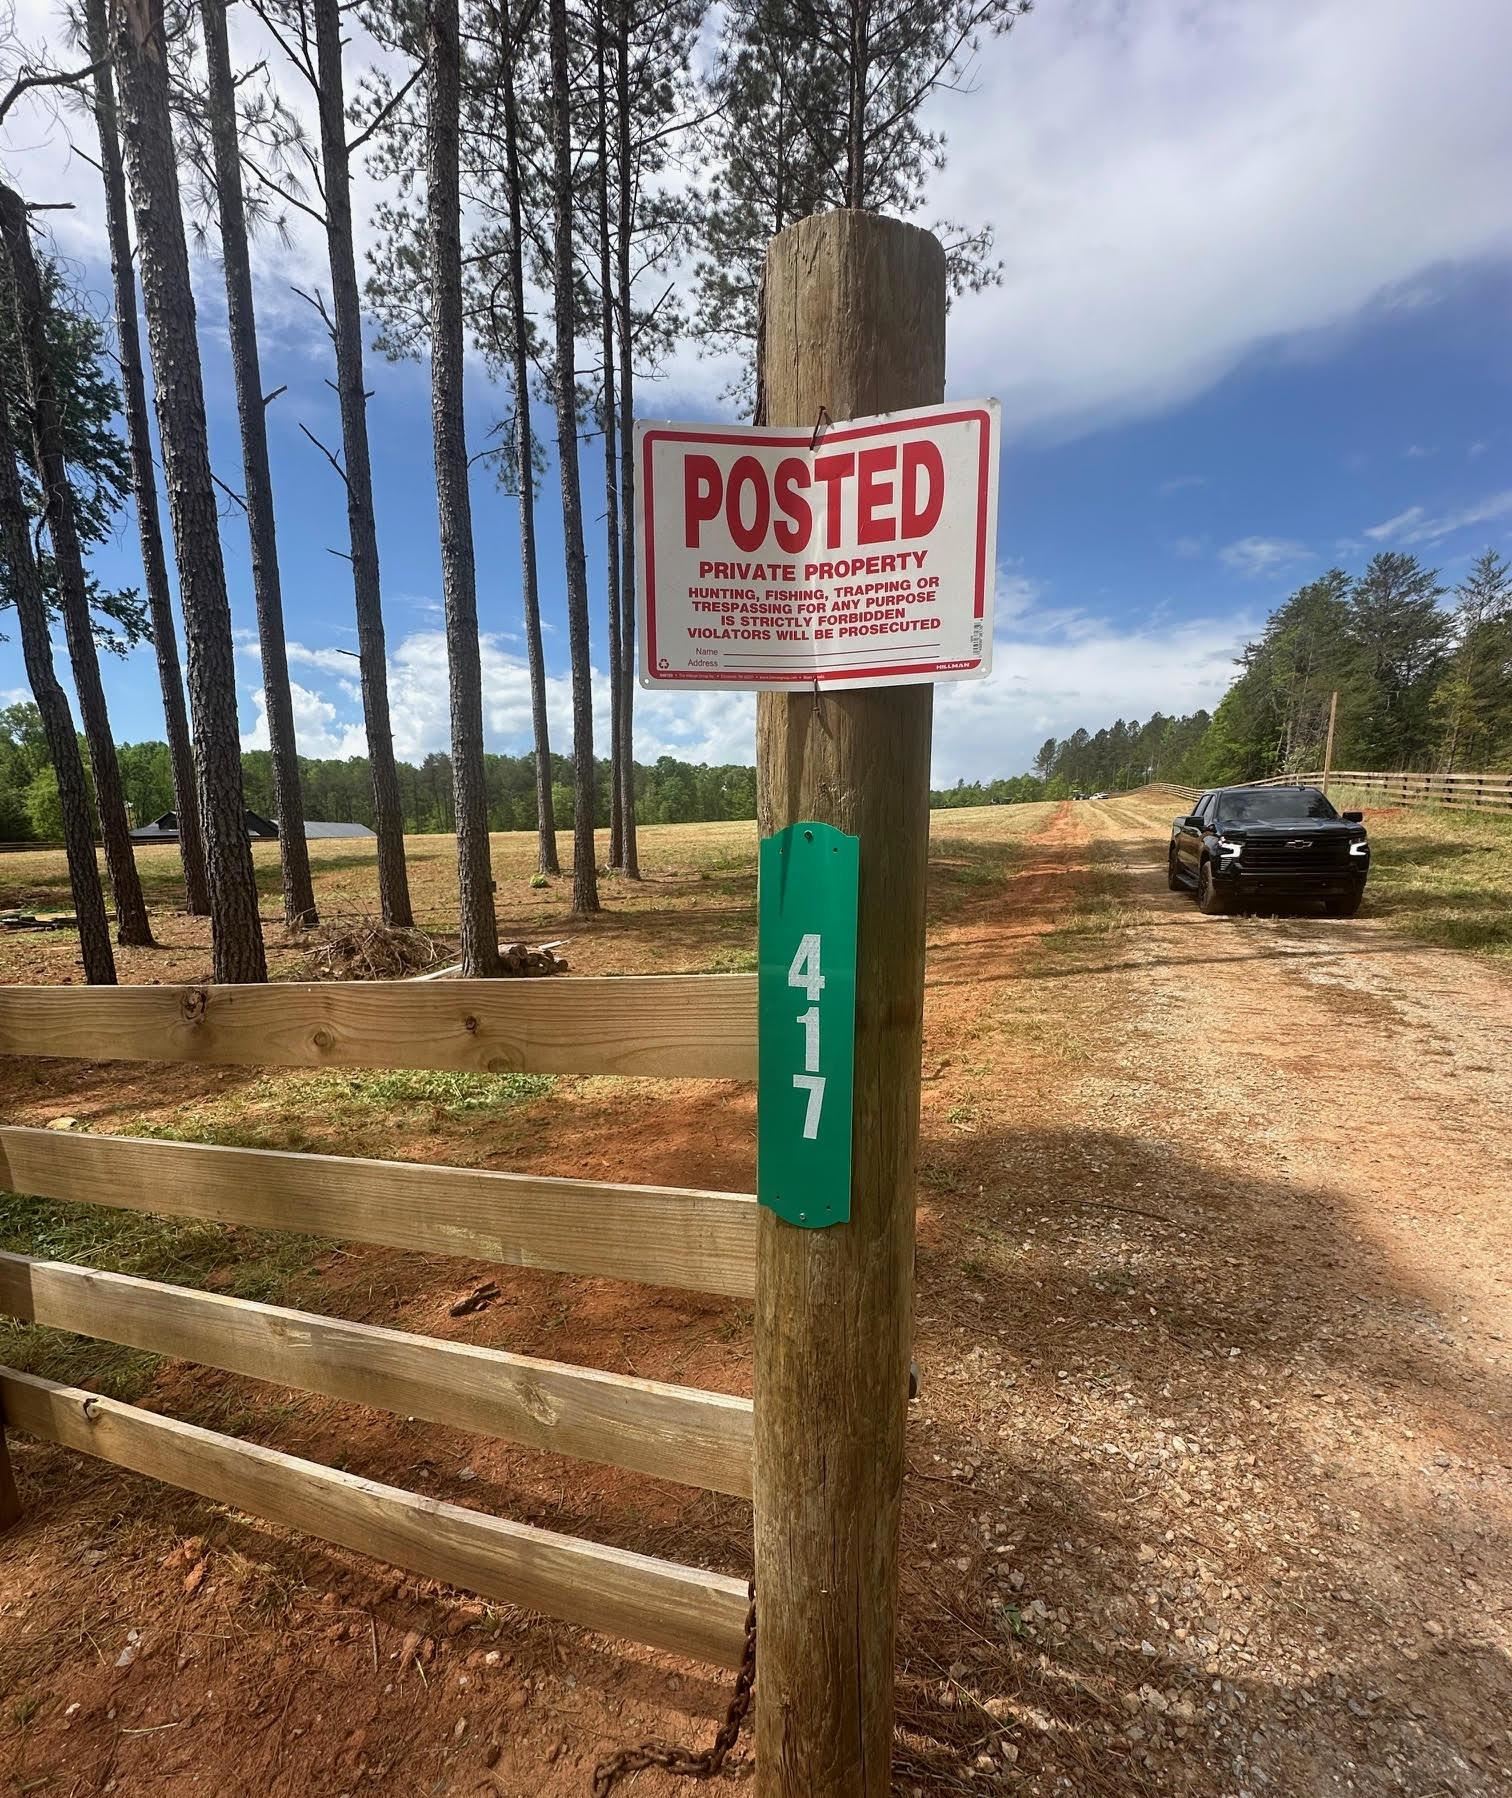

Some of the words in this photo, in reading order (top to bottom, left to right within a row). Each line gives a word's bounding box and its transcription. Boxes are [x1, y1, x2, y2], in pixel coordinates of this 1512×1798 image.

[684, 440, 945, 553] POSTED
[699, 561, 796, 581] PRIVATE
[805, 551, 928, 578] PROPERTY
[688, 587, 760, 601] HUNTING,
[765, 589, 829, 601] FISHING,
[834, 580, 912, 597] TRAPPING
[916, 576, 940, 588] OR
[693, 601, 793, 614] TRESPASSING
[797, 600, 827, 614] FOR
[831, 597, 861, 612] ANY
[866, 590, 936, 607] PURPOSE
[688, 628, 771, 640] VIOLATORS
[776, 629, 809, 640] WILL
[814, 627, 835, 639] BE
[839, 618, 941, 637] PROSECUTED
[721, 615, 736, 626] IS
[740, 616, 813, 627] STRICTLY
[818, 608, 906, 625] FORBIDDEN
[688, 658, 718, 668] Address
[696, 647, 718, 656] Name
[936, 662, 970, 670] HILLMAN
[788, 934, 826, 1139] 417
